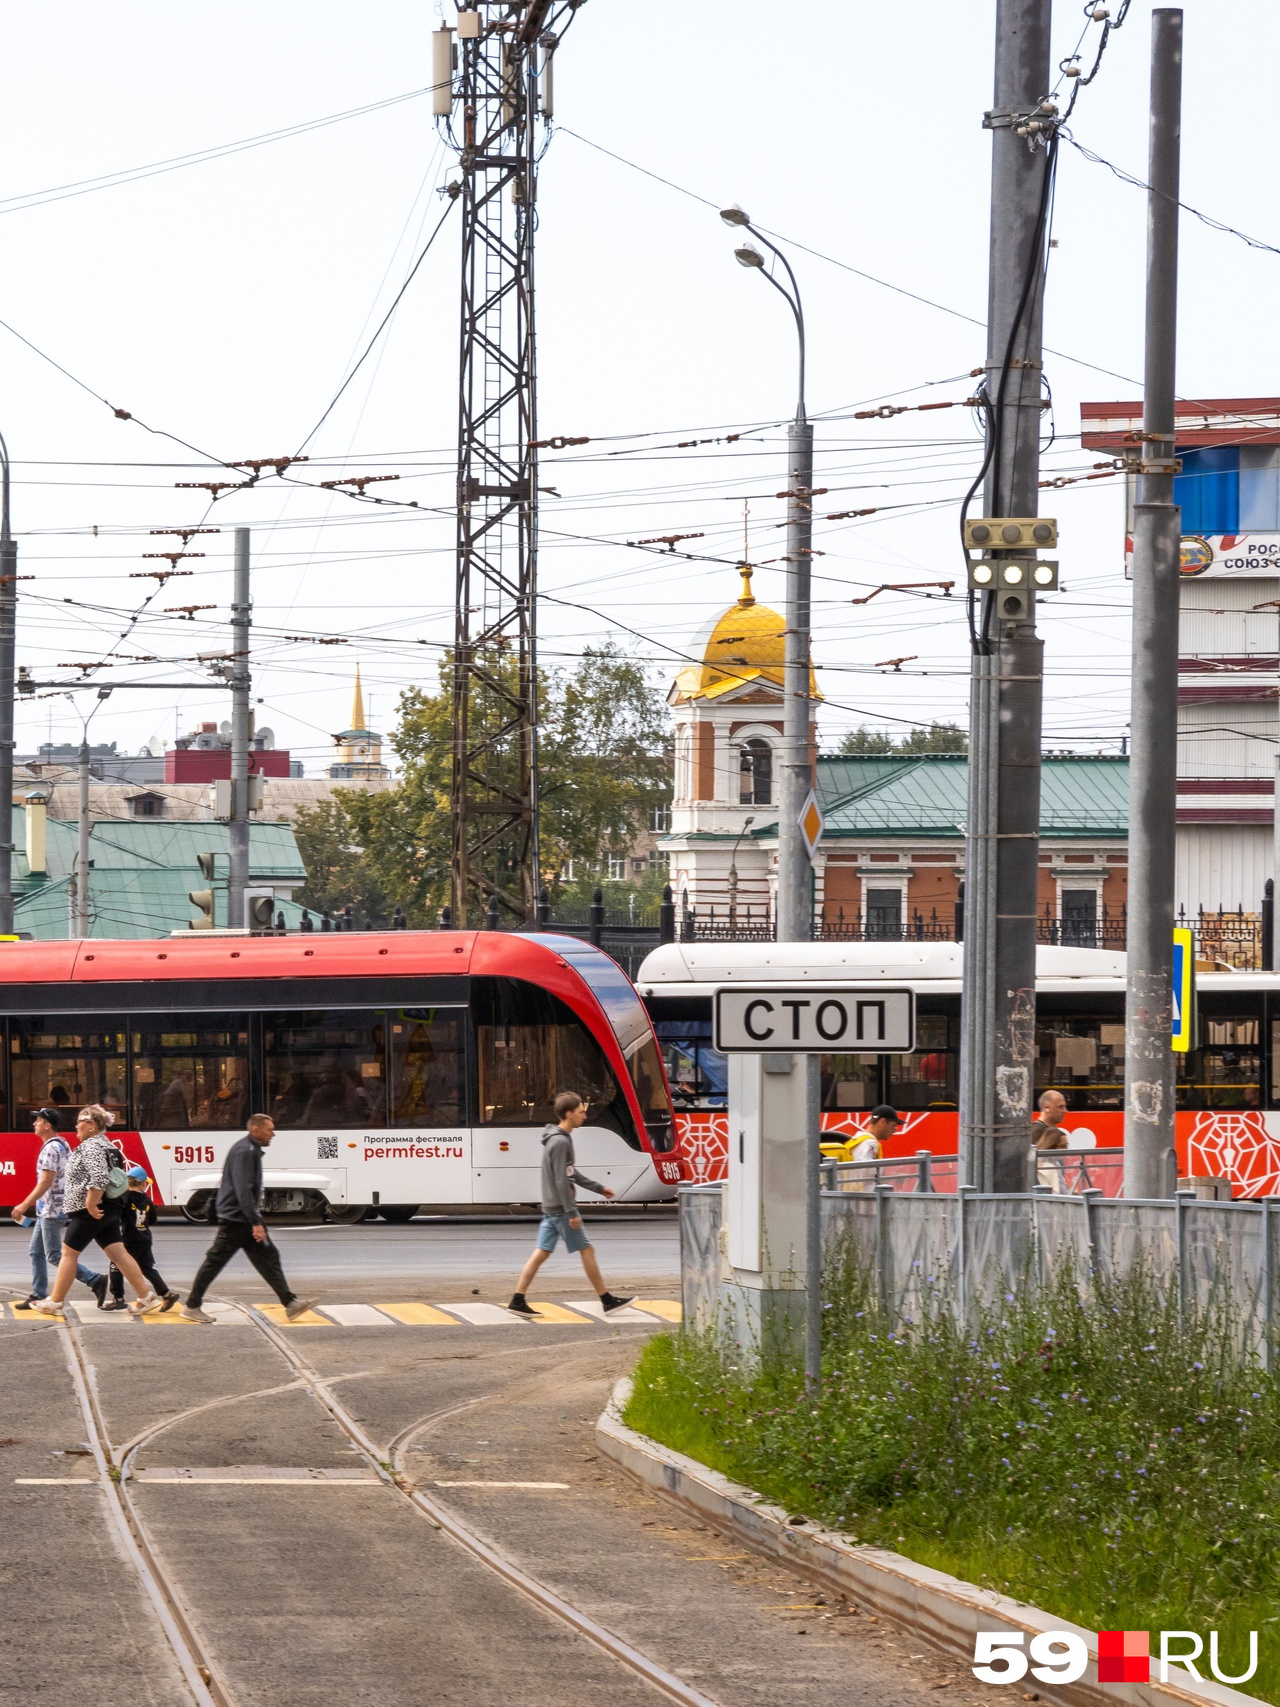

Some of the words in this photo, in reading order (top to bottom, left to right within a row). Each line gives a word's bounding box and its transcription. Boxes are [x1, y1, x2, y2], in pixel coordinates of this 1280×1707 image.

[1248, 544, 1280, 555] РОС
[1224, 558, 1269, 569] СОЮЗ
[744, 999, 886, 1041] СТОП
[363, 1135, 414, 1144] Программа
[415, 1135, 463, 1144] фестиваля
[174, 1145, 215, 1163] 5915
[363, 1144, 463, 1161] permfest.ru
[661, 1161, 681, 1180] 5915
